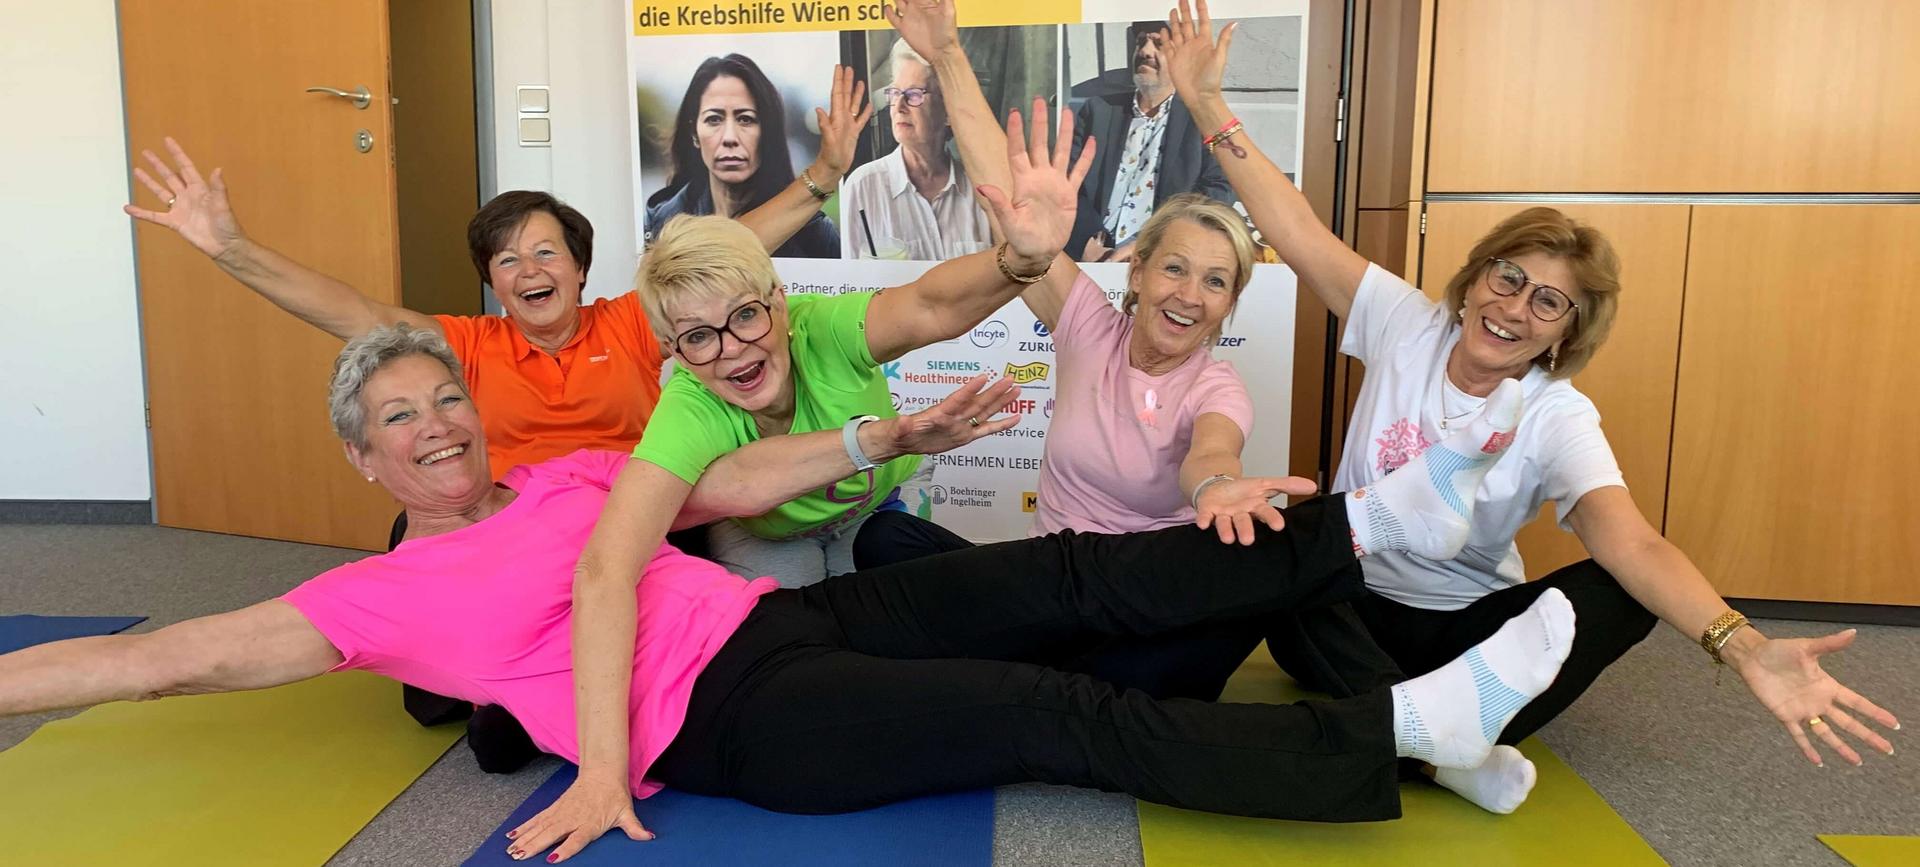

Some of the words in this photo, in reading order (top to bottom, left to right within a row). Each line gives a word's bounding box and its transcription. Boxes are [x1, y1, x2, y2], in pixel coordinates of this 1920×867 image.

[639, 6, 670, 27] die
[677, 2, 785, 26] Krebshilfe
[792, 1, 850, 23] Wien
[792, 282, 836, 296] Partner,
[839, 284, 857, 295] die
[974, 329, 1006, 341] Incyte
[927, 360, 980, 371] SIEMENS
[1007, 366, 1045, 381] HEINZ
[1009, 457, 1042, 470] LEBE
[950, 486, 996, 498] Boehringer
[950, 497, 992, 508] Ingelheim
